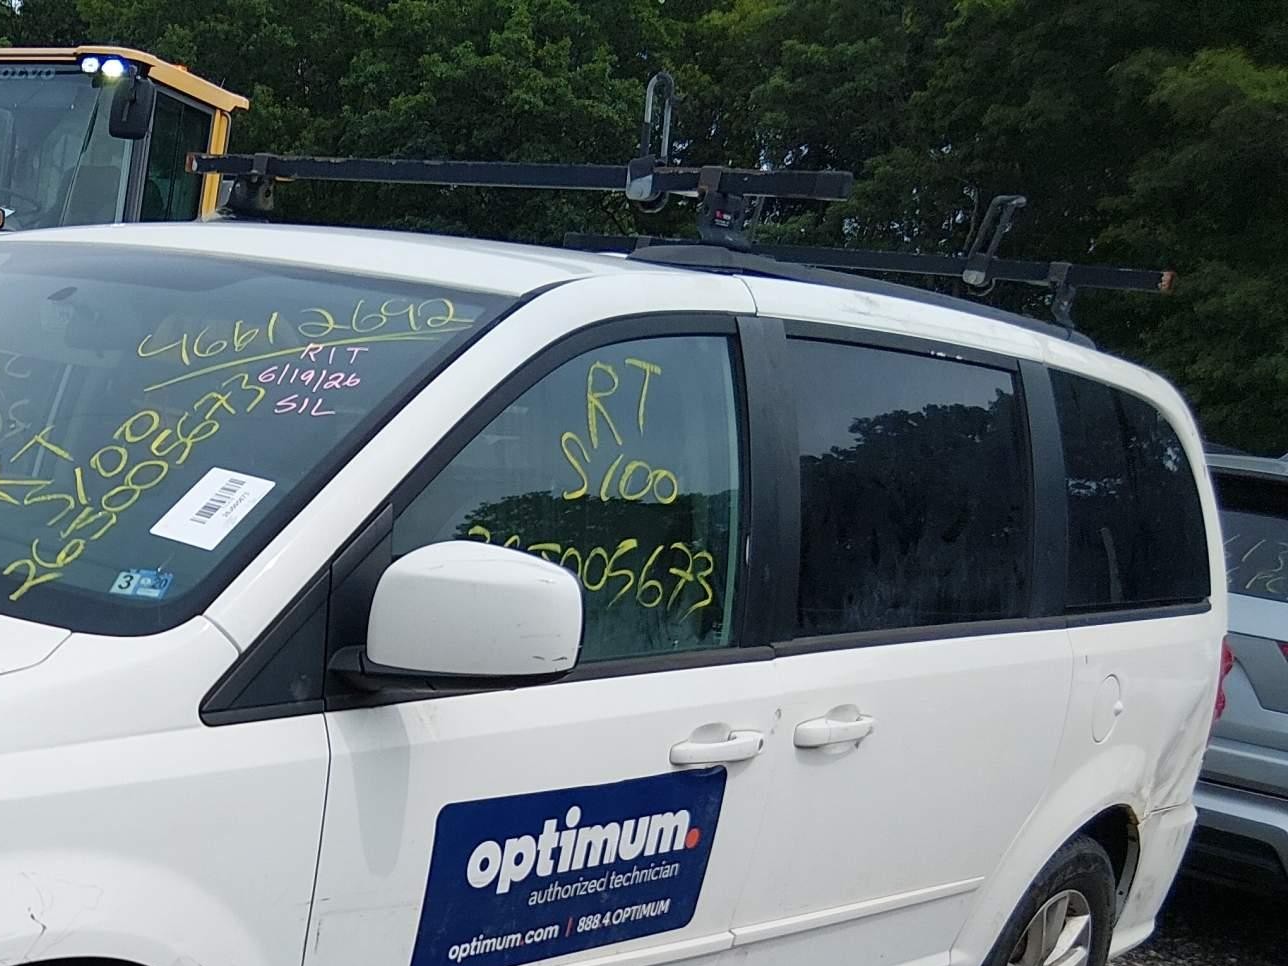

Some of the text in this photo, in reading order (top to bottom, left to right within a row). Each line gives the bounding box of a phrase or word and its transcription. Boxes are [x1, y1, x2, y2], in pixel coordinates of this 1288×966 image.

[300, 342, 369, 366] RIT
[258, 362, 362, 393] 6/19/26
[585, 358, 662, 449] RT
[560, 432, 679, 505] S100
[118, 574, 134, 590] 3
[528, 860, 680, 906] authorized technician
[448, 921, 560, 963] optimum.com
